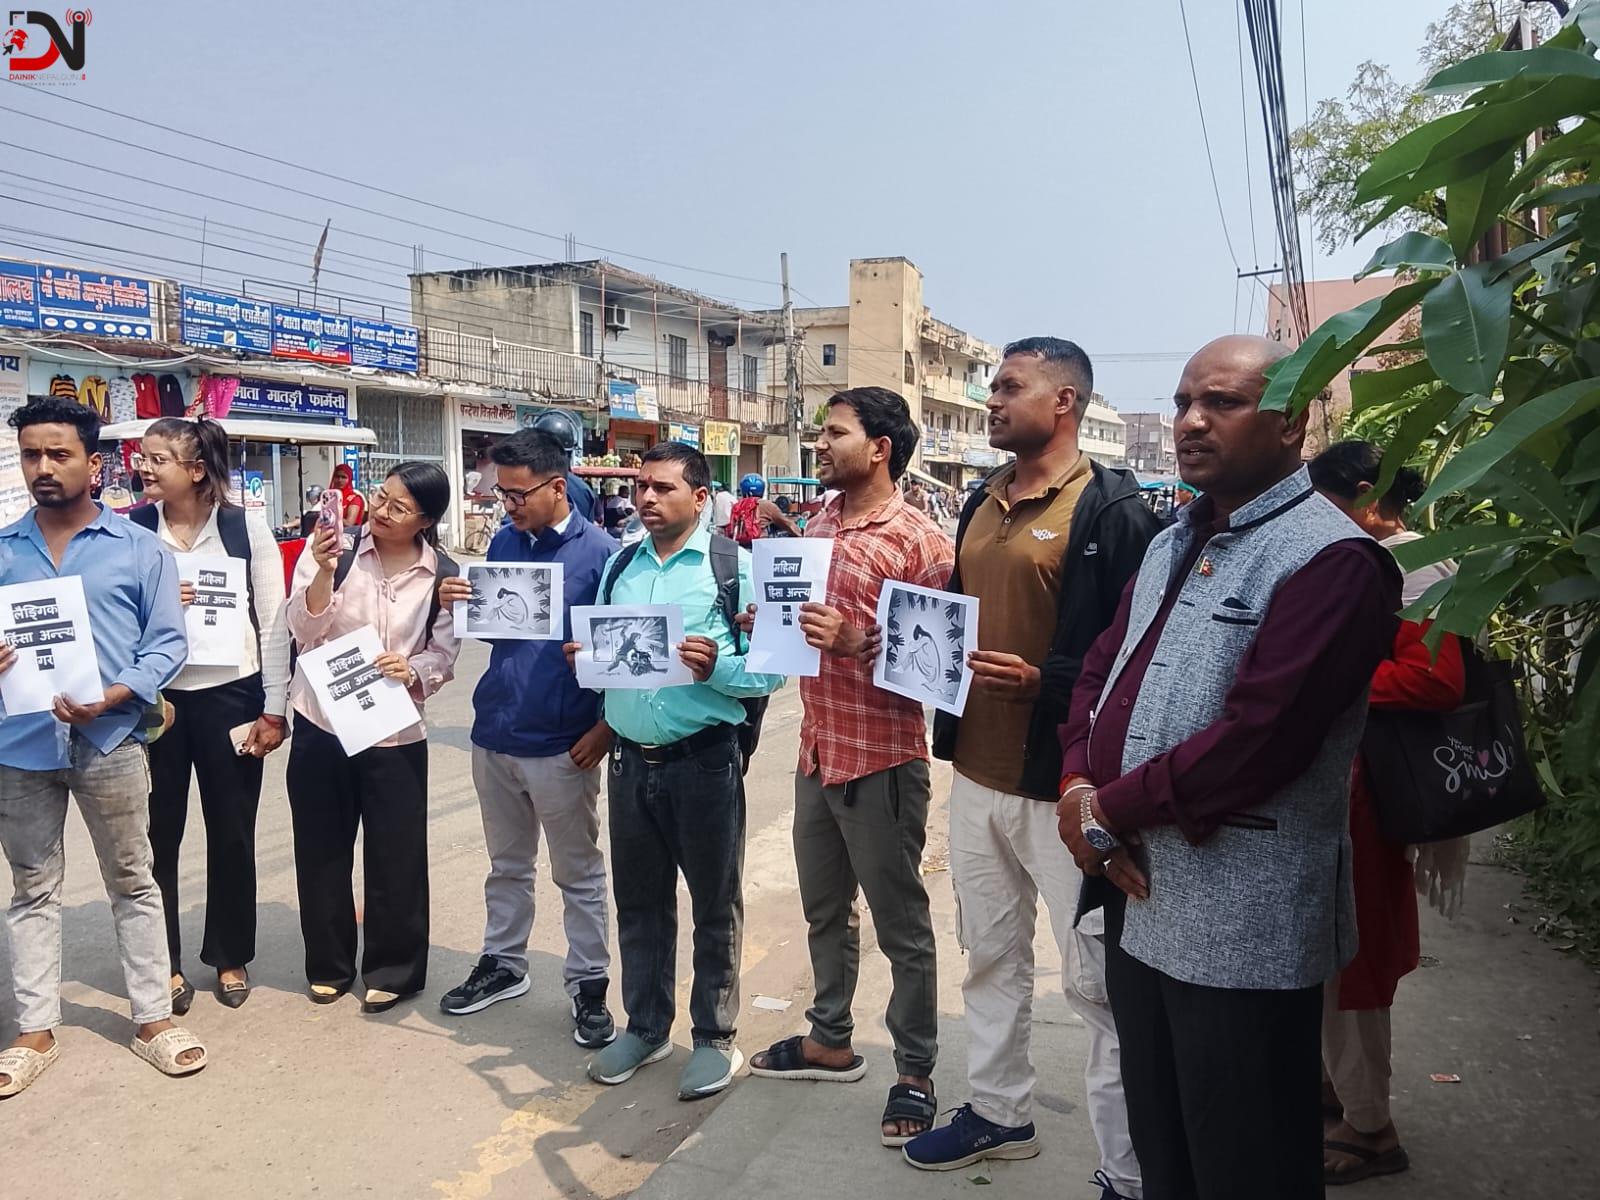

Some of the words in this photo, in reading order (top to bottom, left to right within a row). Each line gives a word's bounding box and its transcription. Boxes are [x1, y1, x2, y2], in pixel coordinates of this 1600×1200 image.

[193, 299, 214, 314] माता
[283, 316, 300, 330] माता
[773, 560, 799, 574] महिला
[198, 573, 225, 585] महिला
[782, 611, 792, 622] गर
[5, 631, 34, 647] हिंसा
[39, 627, 74, 642] अन्त्य
[37, 654, 54, 666] गर
[358, 695, 374, 706] गर
